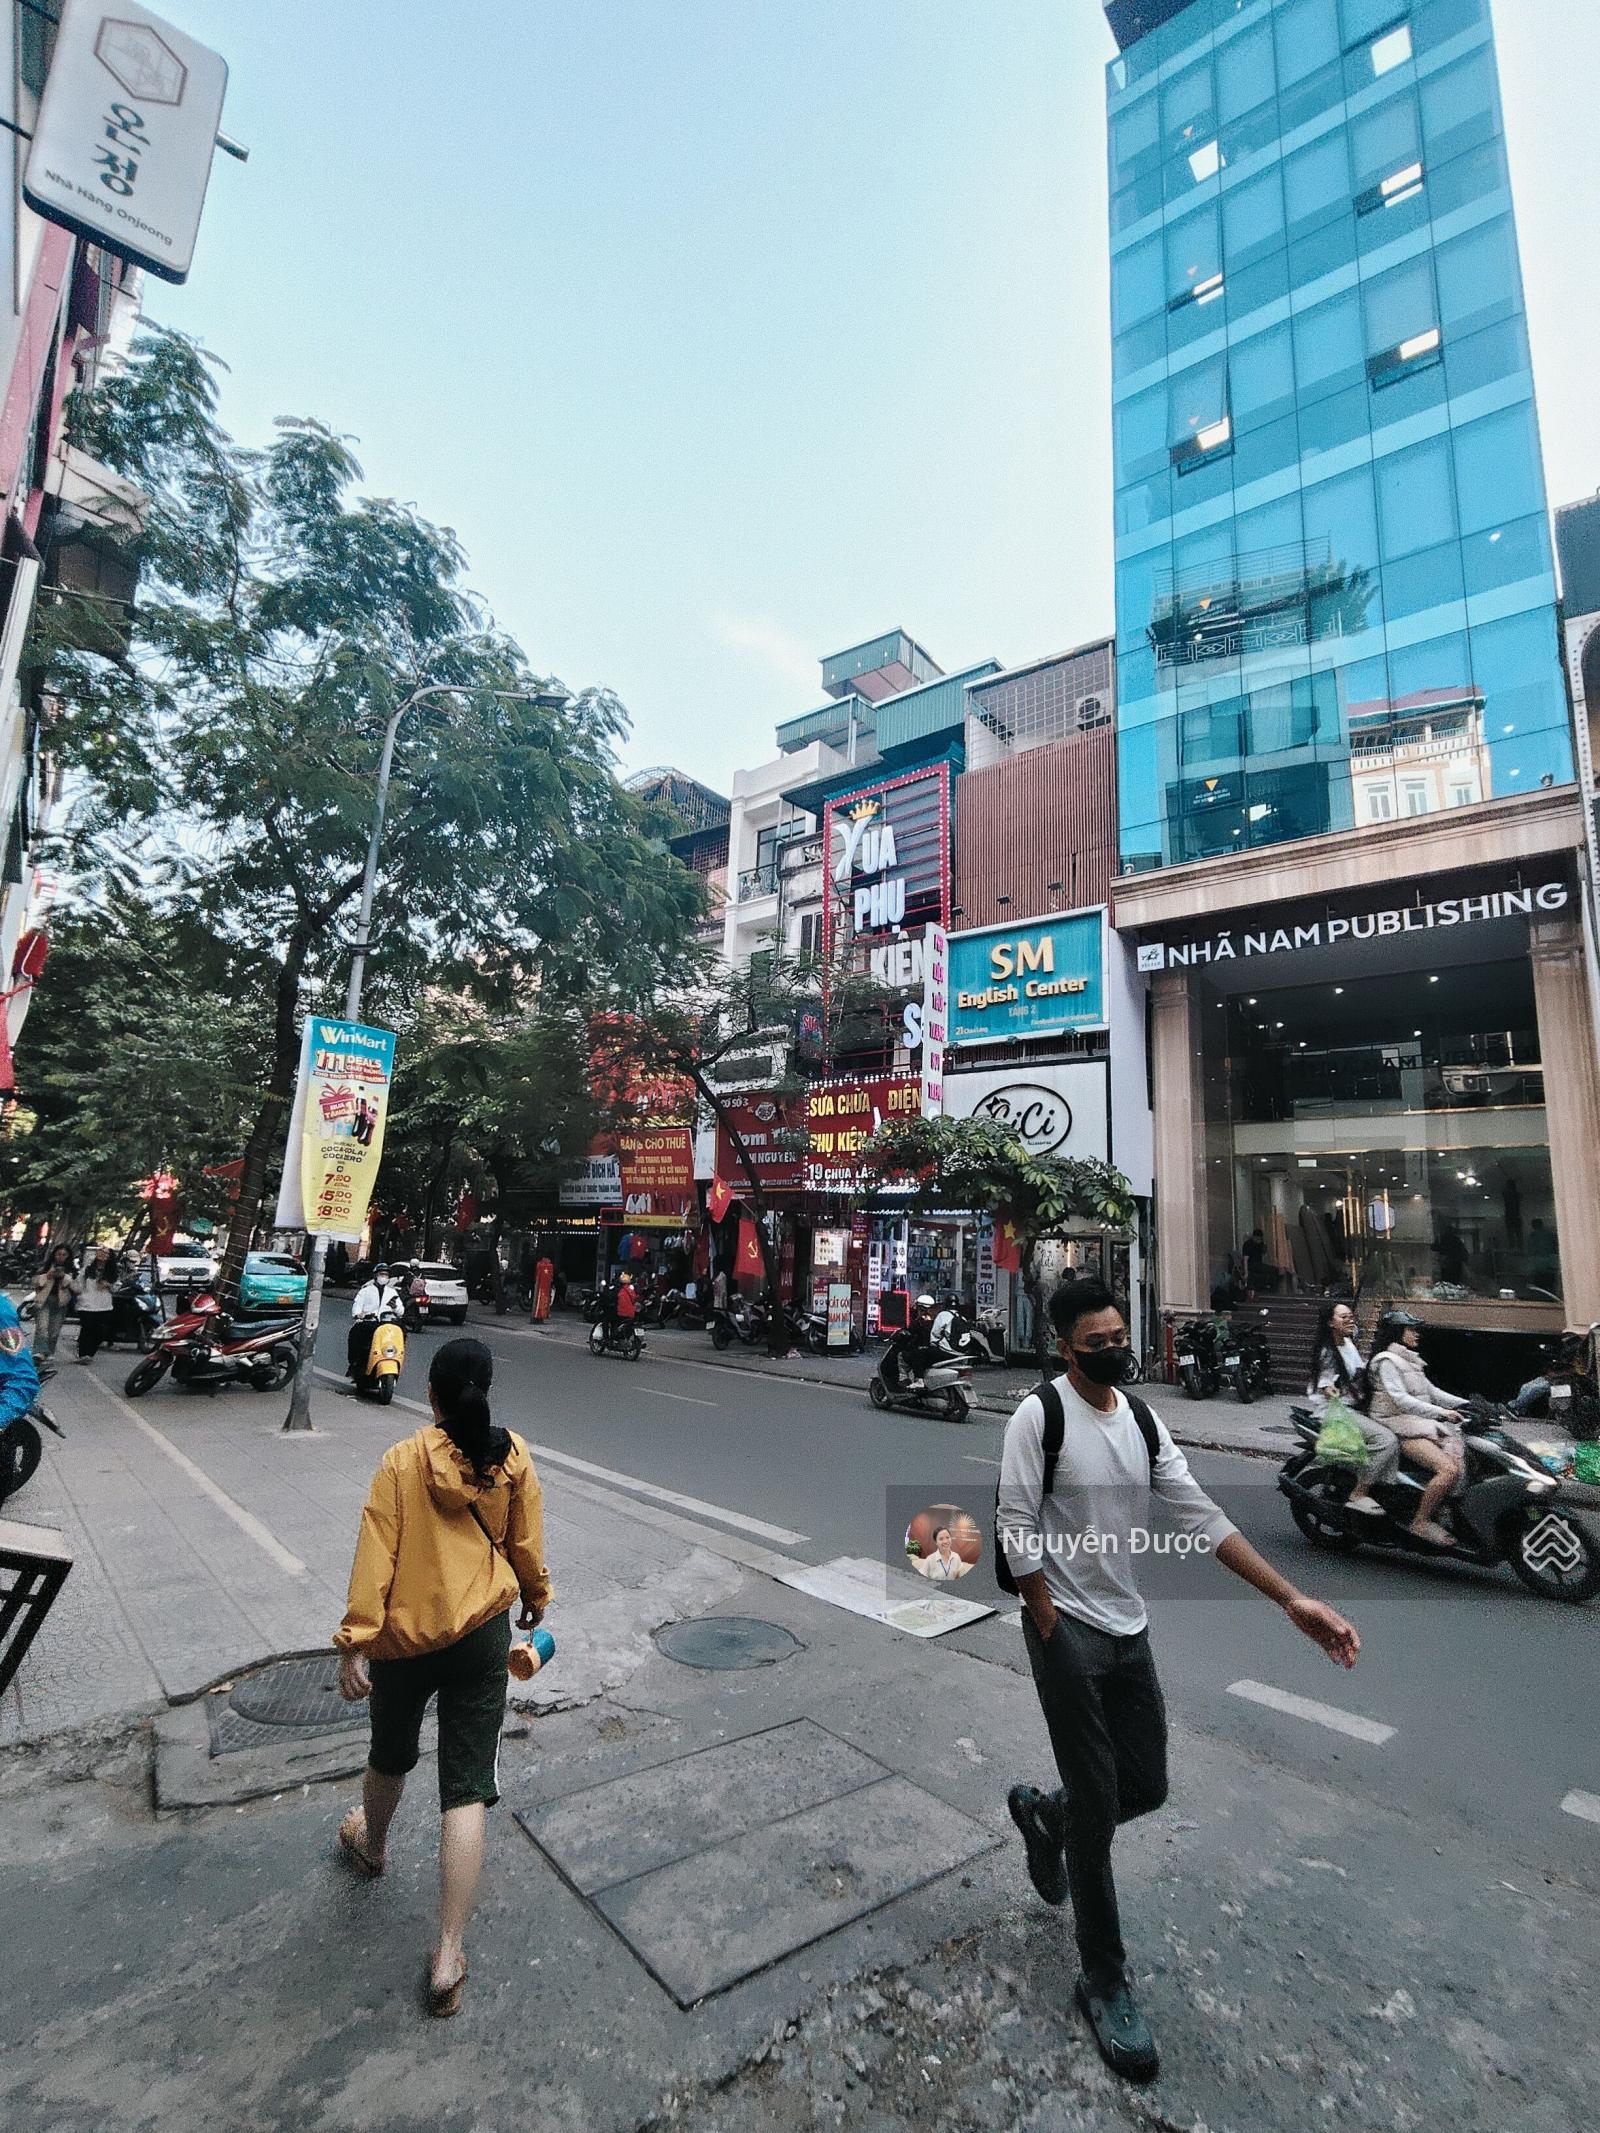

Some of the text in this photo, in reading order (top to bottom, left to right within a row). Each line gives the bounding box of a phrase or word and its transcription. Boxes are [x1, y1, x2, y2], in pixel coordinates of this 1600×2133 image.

[91, 103, 150, 196] 온정
[117, 208, 173, 246] Onjeong
[854, 878, 905, 934] PHỤ
[1168, 882, 1568, 968] NHÃ NAM PUBLISHING
[991, 936, 1055, 980] SM
[957, 976, 1088, 1010] English Center
[320, 1025, 387, 1051] WinMart
[902, 1002, 925, 1050] S
[315, 1048, 346, 1073] 111
[347, 1055, 382, 1069] DEALS
[810, 1088, 834, 1117] SỬA
[837, 1087, 871, 1115] CHỮA
[645, 1137, 665, 1150] CHO
[808, 1163, 823, 1180] 19
[980, 1284, 992, 1294] 19
